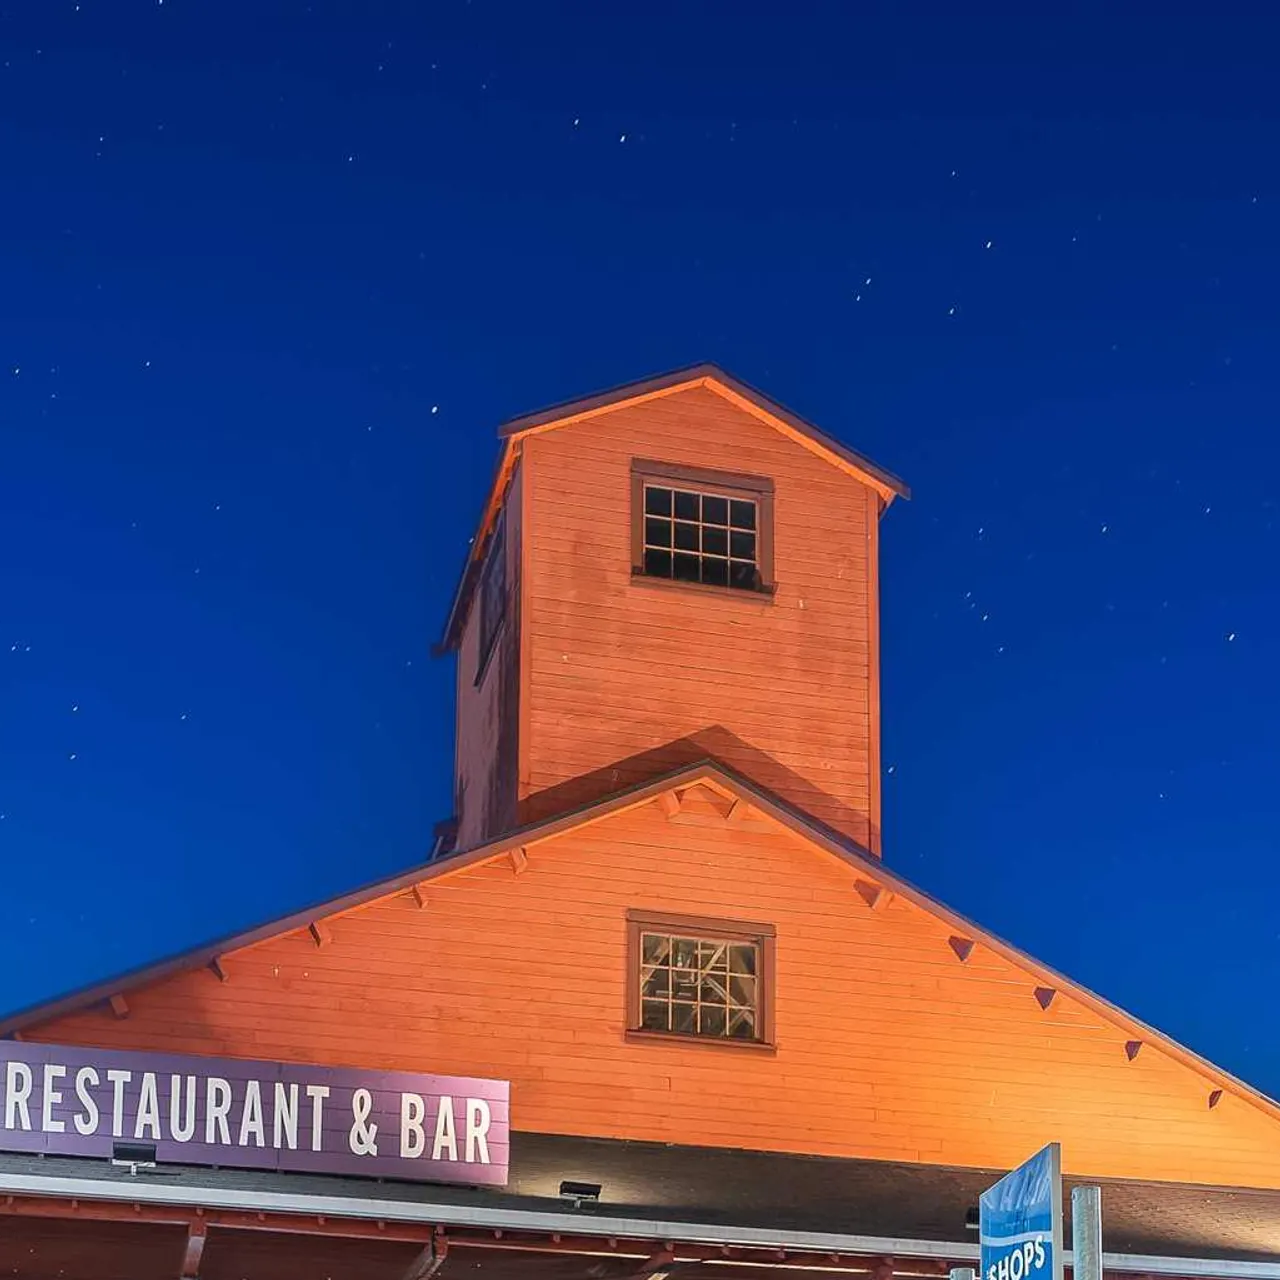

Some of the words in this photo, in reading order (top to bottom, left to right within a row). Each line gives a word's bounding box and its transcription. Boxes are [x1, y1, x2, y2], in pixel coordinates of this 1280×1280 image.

[4, 1061, 331, 1152] RESTAURANT
[348, 1088, 380, 1157] &
[399, 1092, 493, 1163] BAR
